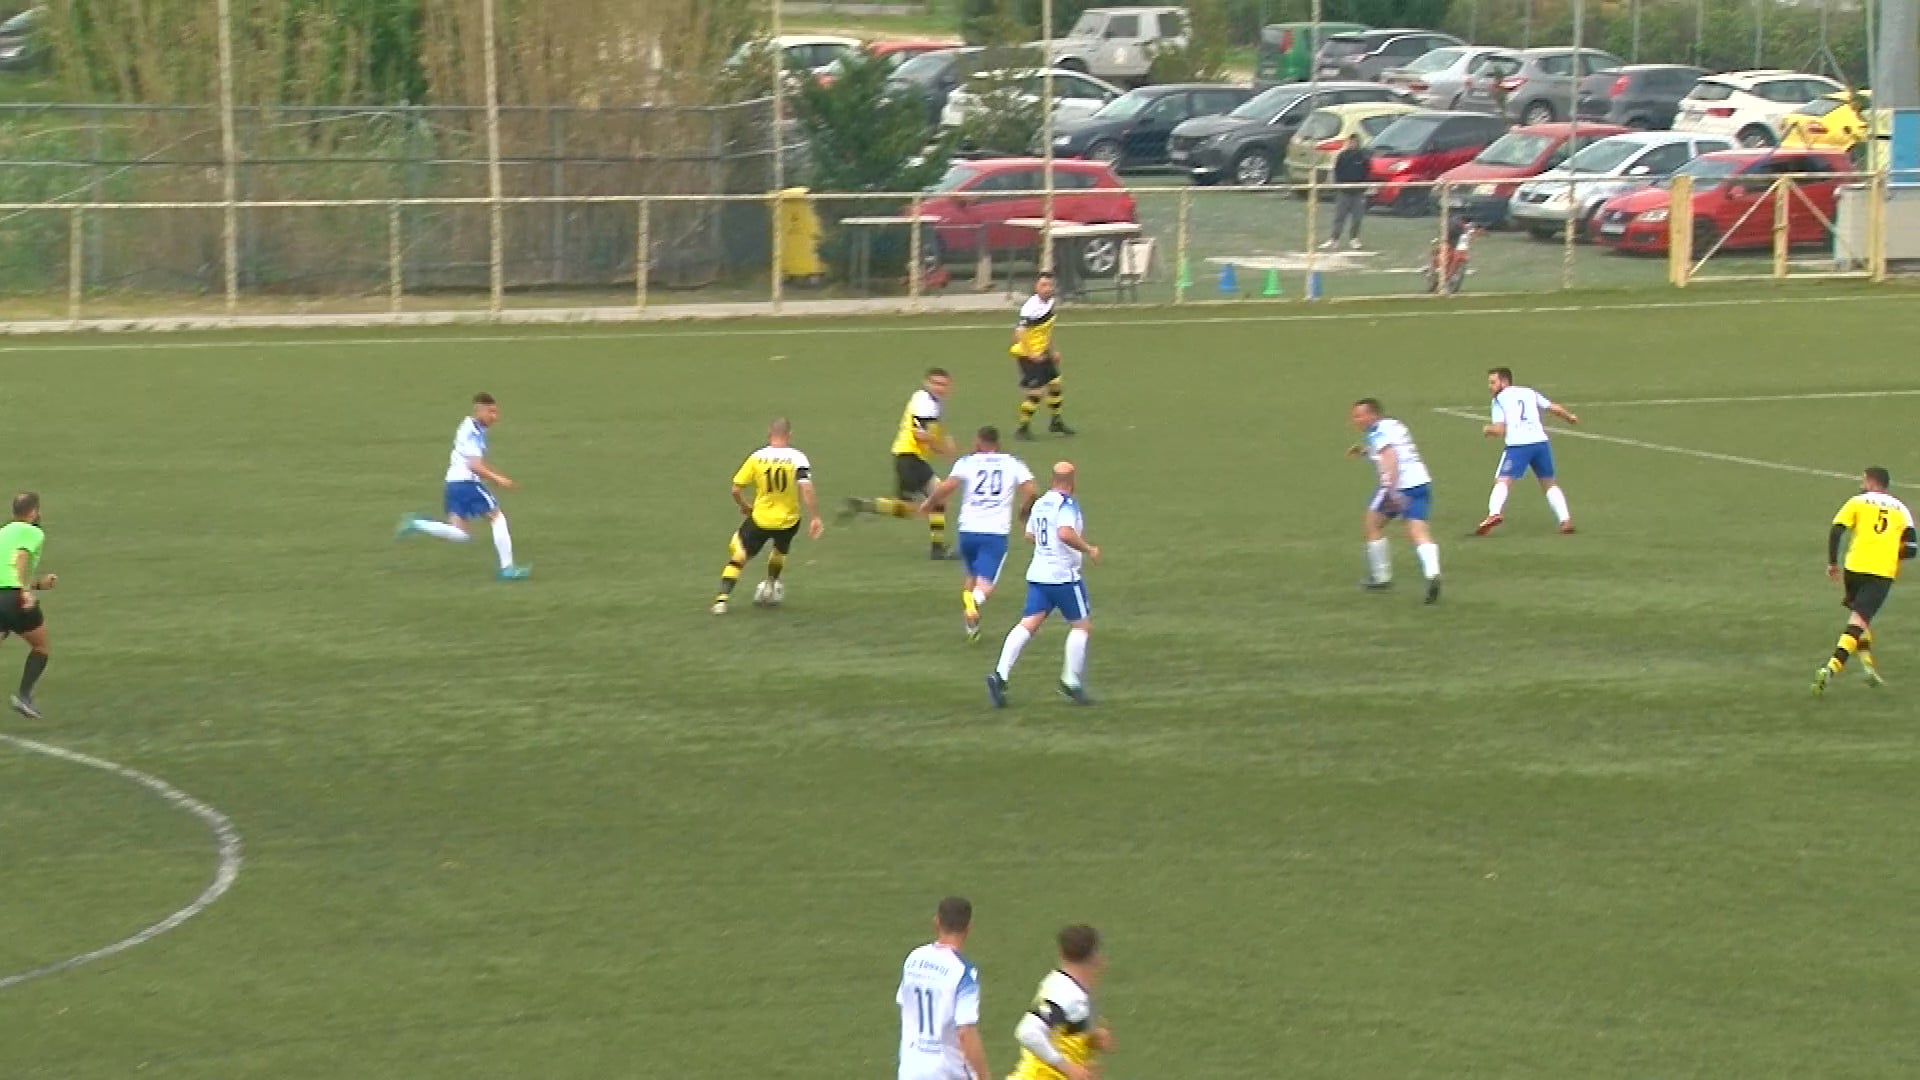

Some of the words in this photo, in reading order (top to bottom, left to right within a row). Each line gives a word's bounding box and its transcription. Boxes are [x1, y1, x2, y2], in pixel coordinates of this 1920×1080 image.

[1517, 399, 1528, 421] 2
[764, 466, 788, 493] 10
[974, 469, 1004, 496] 20
[1873, 509, 1889, 535] 5
[913, 986, 935, 1037] 11
